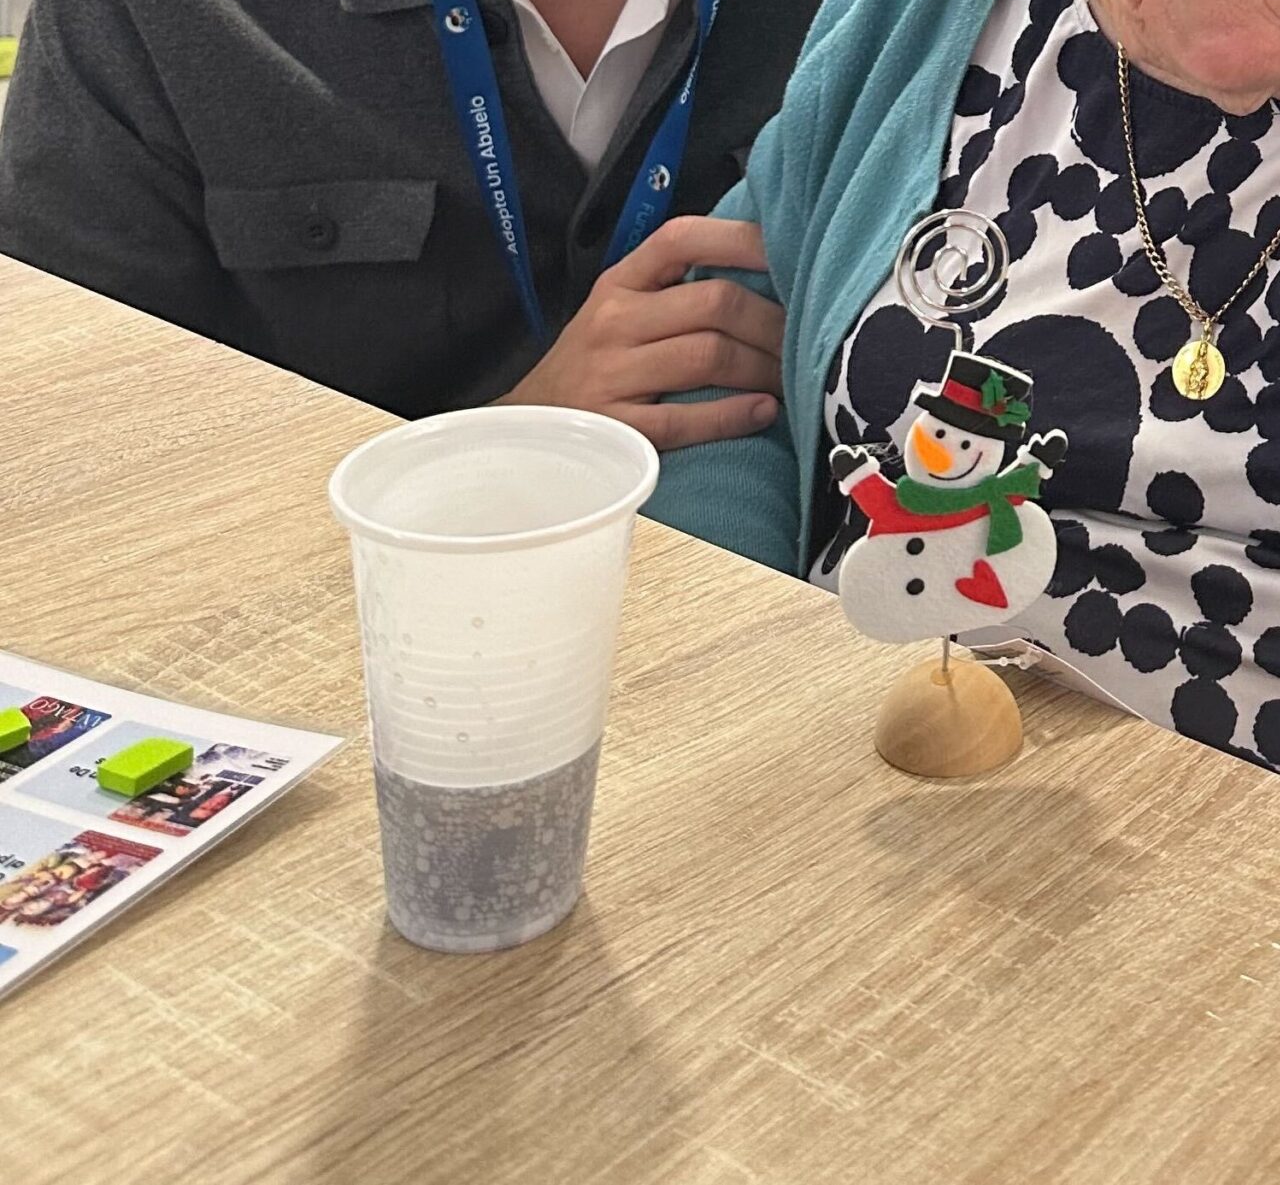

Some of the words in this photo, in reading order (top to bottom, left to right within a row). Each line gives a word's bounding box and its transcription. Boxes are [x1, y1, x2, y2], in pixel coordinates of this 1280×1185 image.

[470, 94, 497, 159] Abuelo
[486, 162, 502, 188] Un
[494, 190, 519, 255] Adopta
